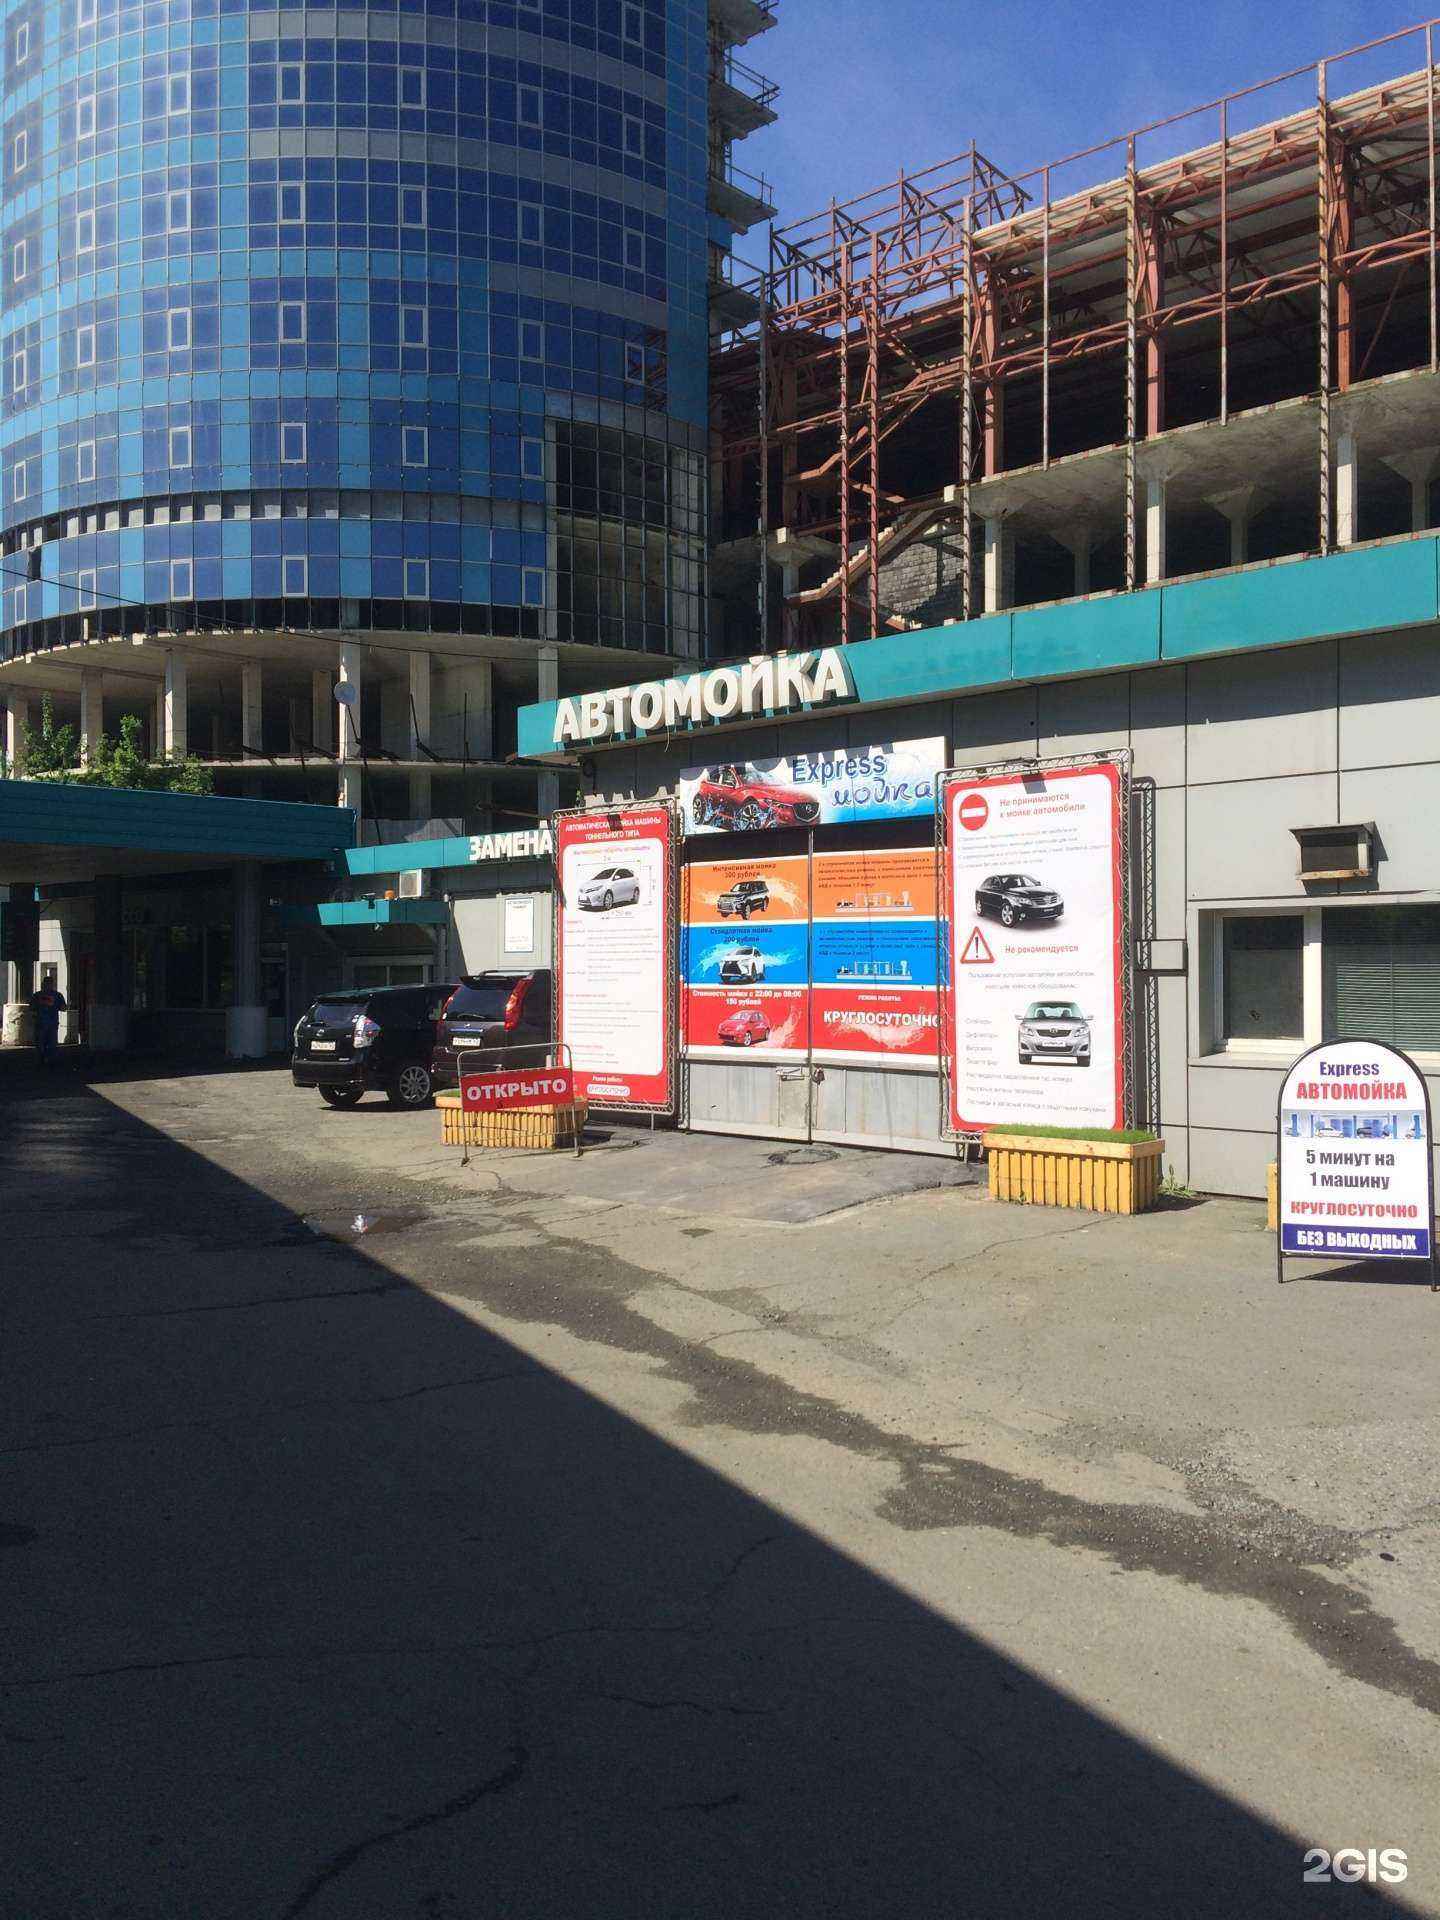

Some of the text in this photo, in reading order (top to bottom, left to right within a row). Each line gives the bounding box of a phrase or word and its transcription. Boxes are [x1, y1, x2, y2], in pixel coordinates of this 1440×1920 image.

[553, 648, 850, 742] АВТОМОЙКА
[792, 755, 887, 785] Express
[832, 777, 933, 806] мойка
[1012, 793, 1069, 806] принимаются
[1006, 808, 1031, 818] мойке
[1033, 803, 1086, 815] автомобили
[566, 821, 614, 832] АВТОМАТИЧЕСКА
[469, 828, 553, 861] ЗАМЕНА
[1005, 944, 1079, 955] Не рекомендуется
[823, 1010, 942, 1028] КРУГЛОСУТОЧНО
[1319, 1061, 1380, 1078] Express
[466, 1078, 568, 1101] ОТКРЫТО
[1296, 1079, 1408, 1100] АВТОМОЙКА
[1306, 1149, 1395, 1167] 5 минут на
[1310, 1171, 1390, 1190] 1 машину
[1290, 1201, 1418, 1219] КРУГЛОСУТОЧНО
[1296, 1229, 1417, 1251] БЕЗ ВЫХОДНЫХ
